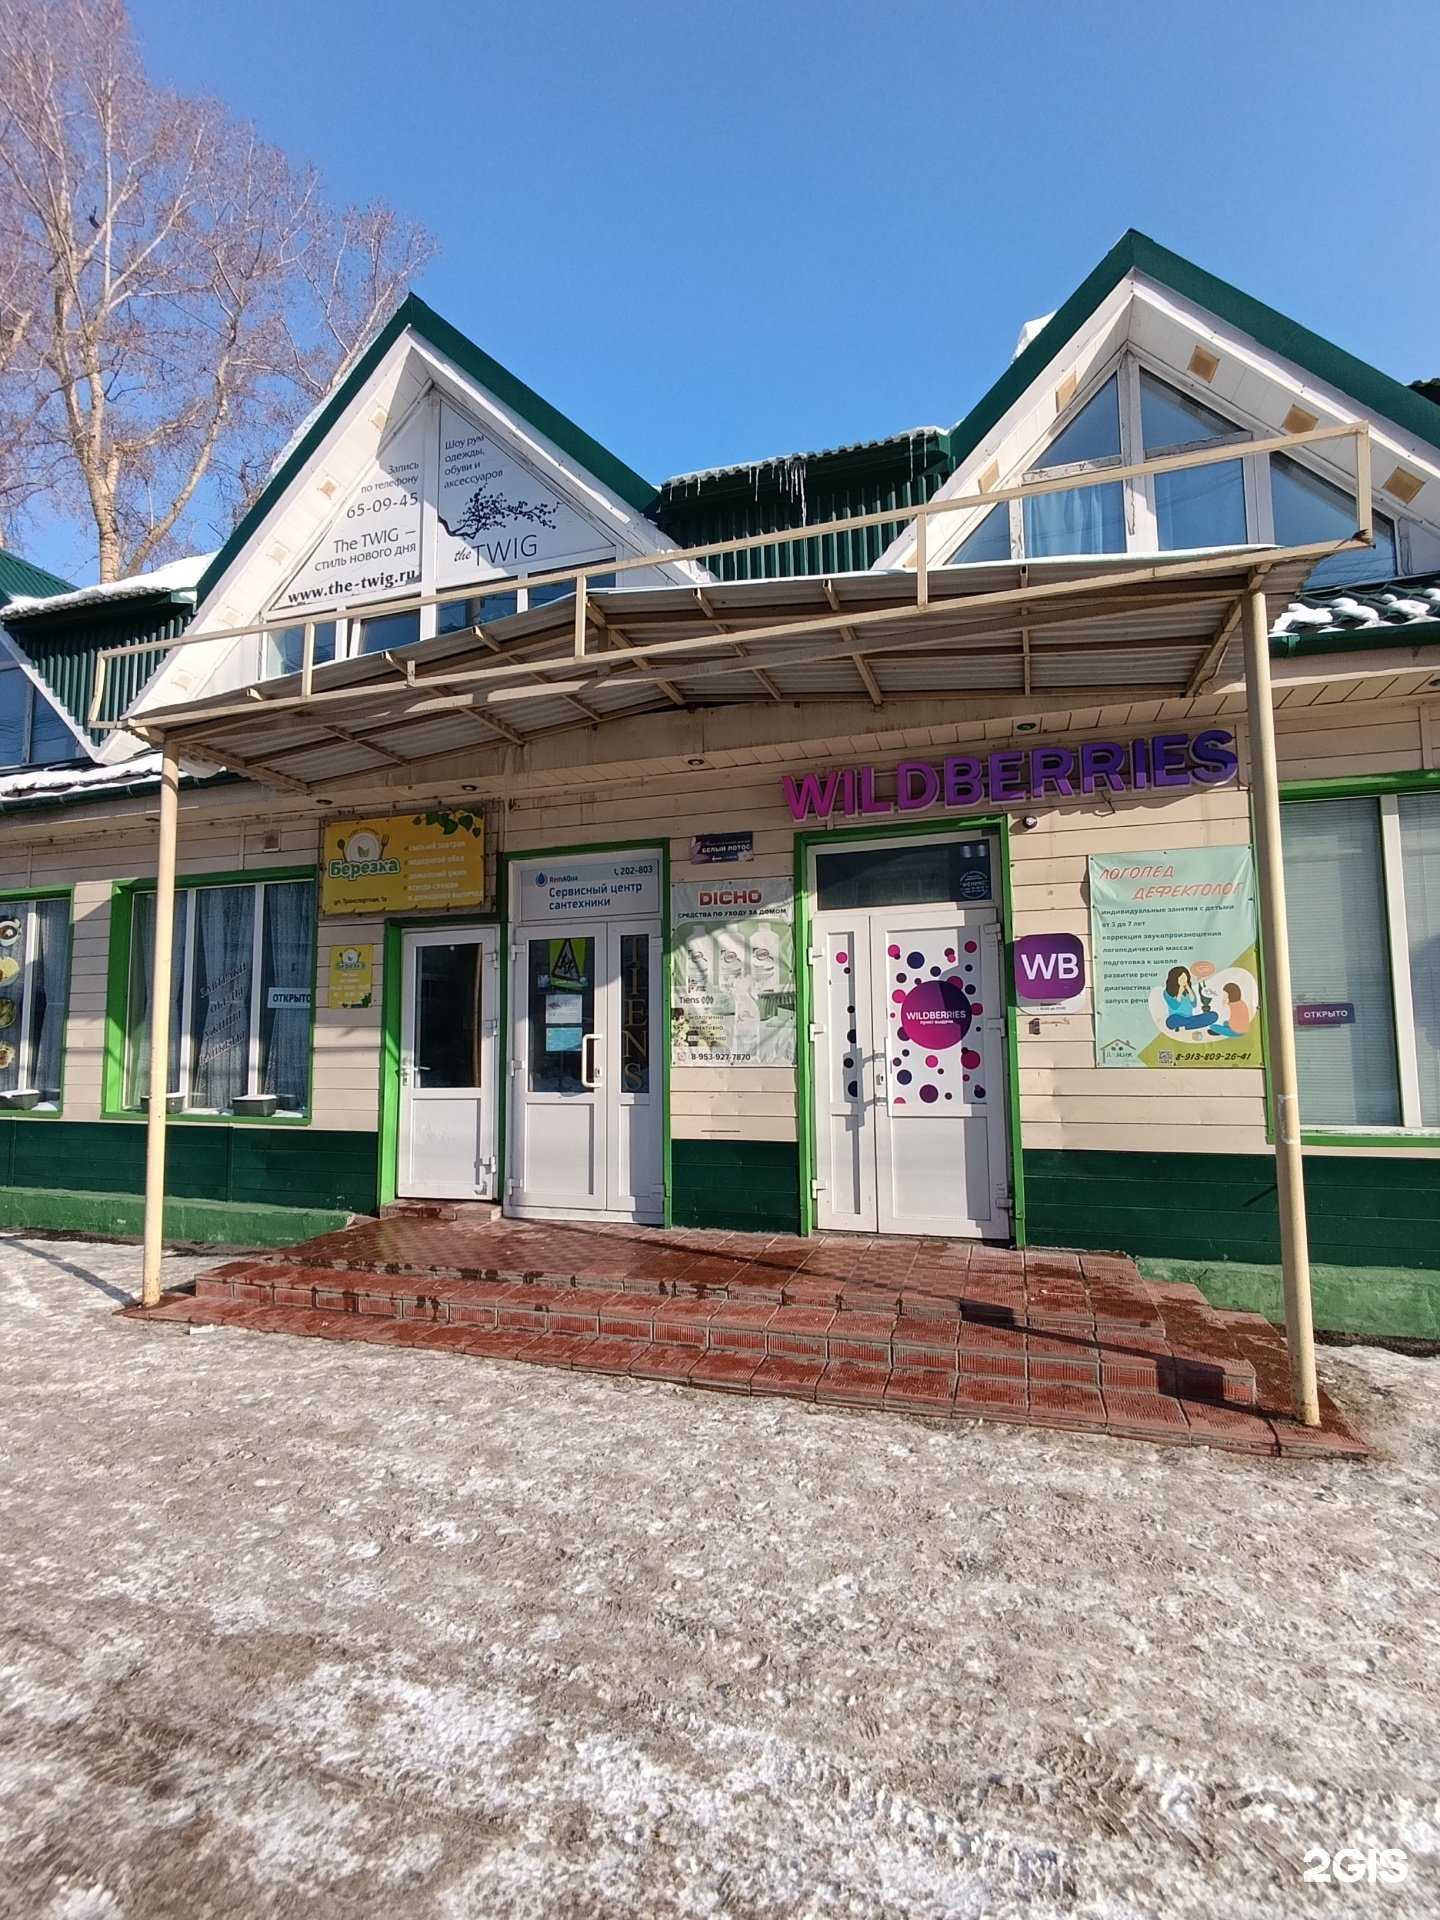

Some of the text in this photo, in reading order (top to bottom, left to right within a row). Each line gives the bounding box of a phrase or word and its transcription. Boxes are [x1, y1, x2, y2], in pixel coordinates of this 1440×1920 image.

[445, 439, 465, 450] Шоу
[387, 462, 420, 475] Запись
[444, 461, 481, 475] обуви и
[361, 474, 419, 494] по телефону
[444, 469, 503, 488] аксессуаров
[346, 491, 418, 519] 65-09-45
[333, 539, 358, 554] The
[361, 527, 399, 547] TWIG
[454, 534, 537, 566] the TWIG
[288, 570, 415, 603] www.the-twig.ru
[782, 729, 1238, 823] WILDBERRIES
[330, 859, 399, 880] Березка
[620, 865, 653, 876] 202-803
[1100, 865, 1175, 880] ЛОГОПЕД
[549, 883, 642, 899] Сервисный центр
[699, 889, 762, 906] DICHO
[1133, 882, 1245, 900] ДЕФЕКТОЛОГ
[549, 898, 611, 910] сантехники
[678, 911, 712, 919] СРЕДСТВА
[724, 910, 746, 918] УХОДУ
[1101, 907, 1166, 916] индивидуальные
[1143, 931, 1222, 940] звукопроизношения
[1102, 945, 1164, 953] логопедический
[1021, 953, 1079, 980] WB
[272, 993, 312, 1003] ОТКРЫТО
[679, 996, 700, 1004] Tiens
[622, 935, 648, 1091] TIENS
[906, 1010, 967, 1020] WILDBERRIES
[1303, 1010, 1348, 1018] ОТКРЫТО
[691, 1053, 751, 1061] 8-953-927-7870
[1175, 1052, 1251, 1061] 8-913-809-26-41
